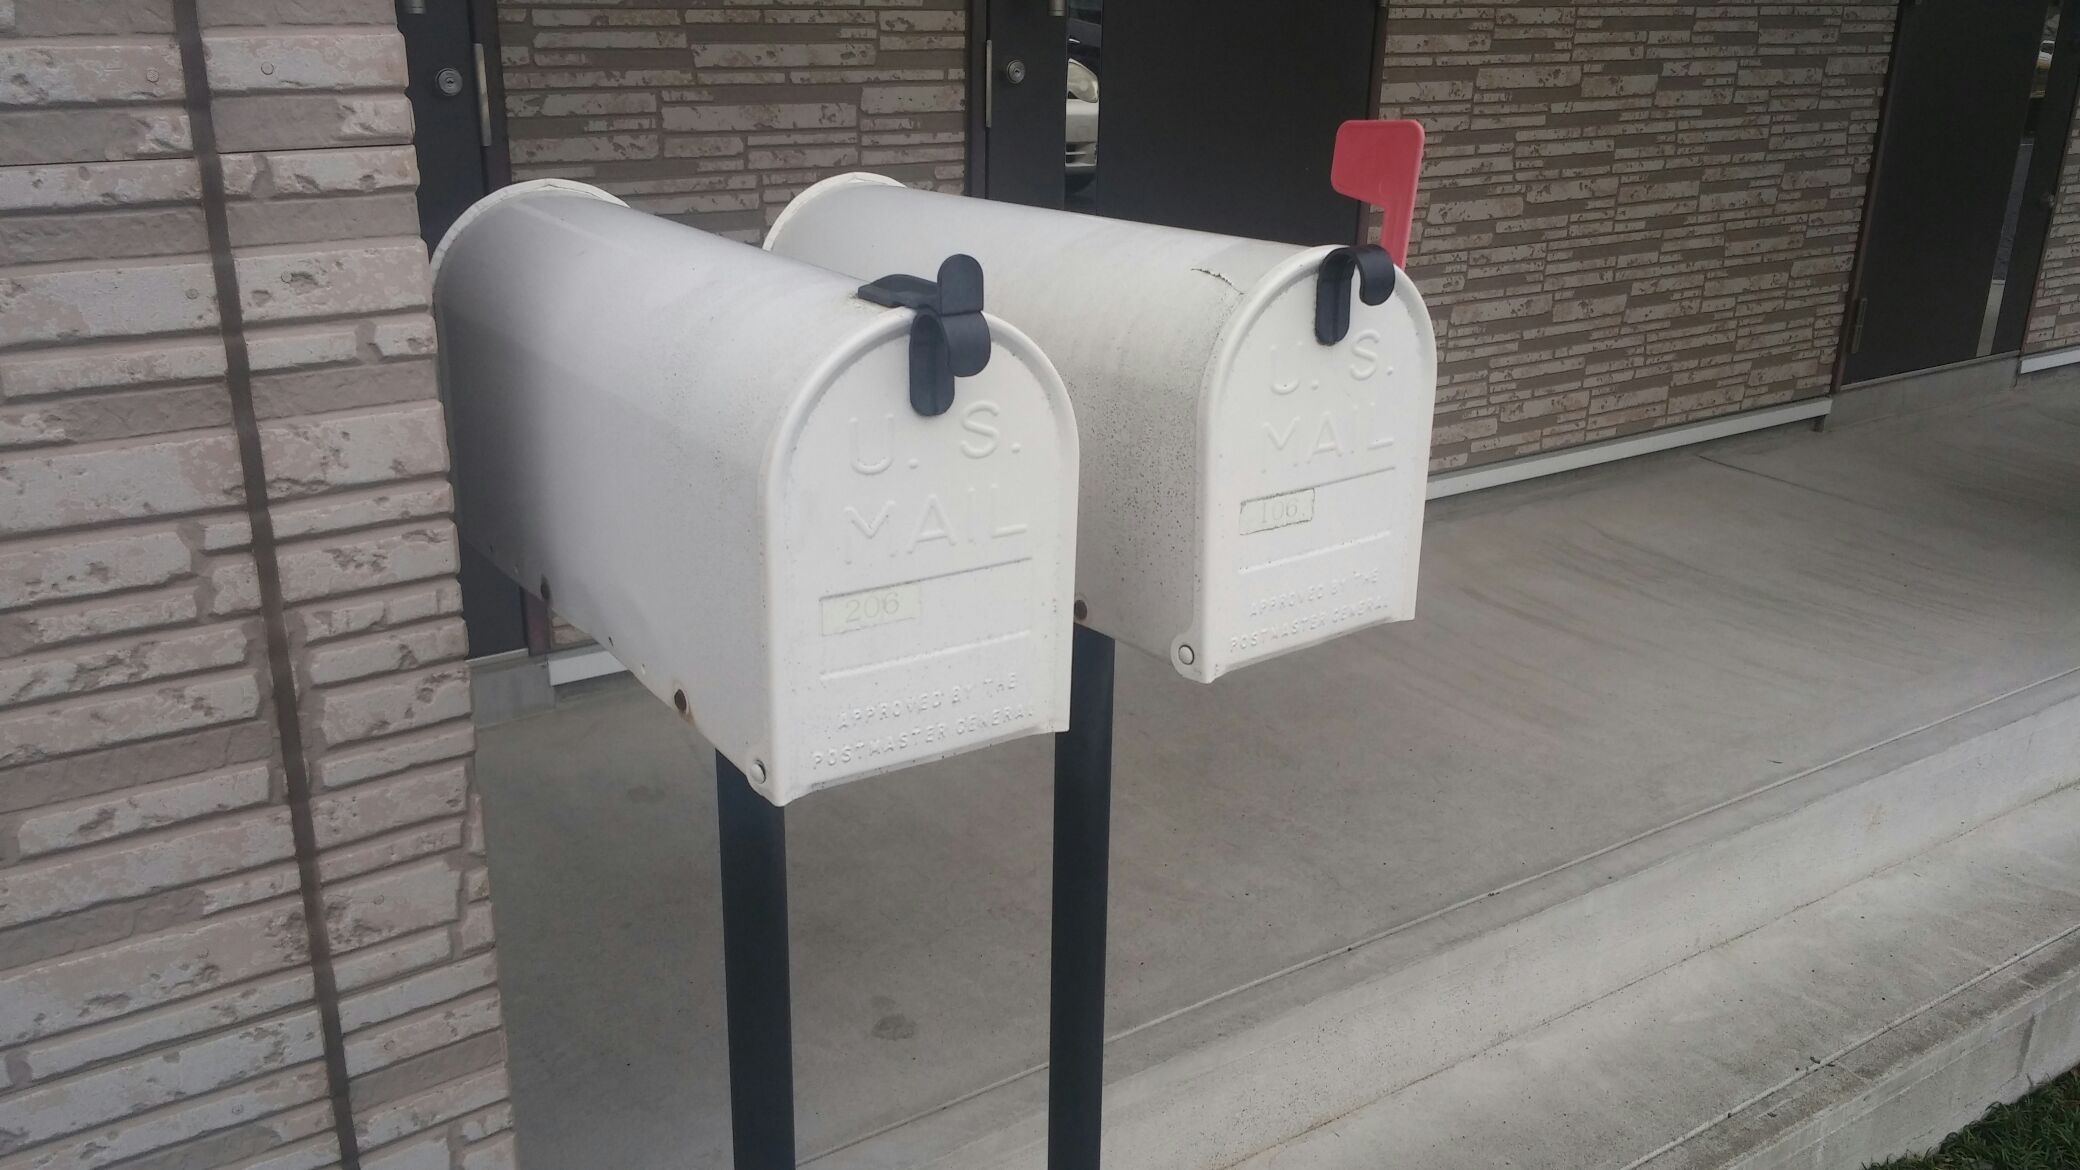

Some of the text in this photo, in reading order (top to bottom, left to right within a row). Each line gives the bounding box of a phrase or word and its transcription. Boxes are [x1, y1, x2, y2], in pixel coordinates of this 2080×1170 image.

[850, 400, 1022, 476] U. S.
[1262, 401, 1395, 474] MAIL
[844, 484, 1029, 565] MAIL
[845, 591, 900, 623] 206
